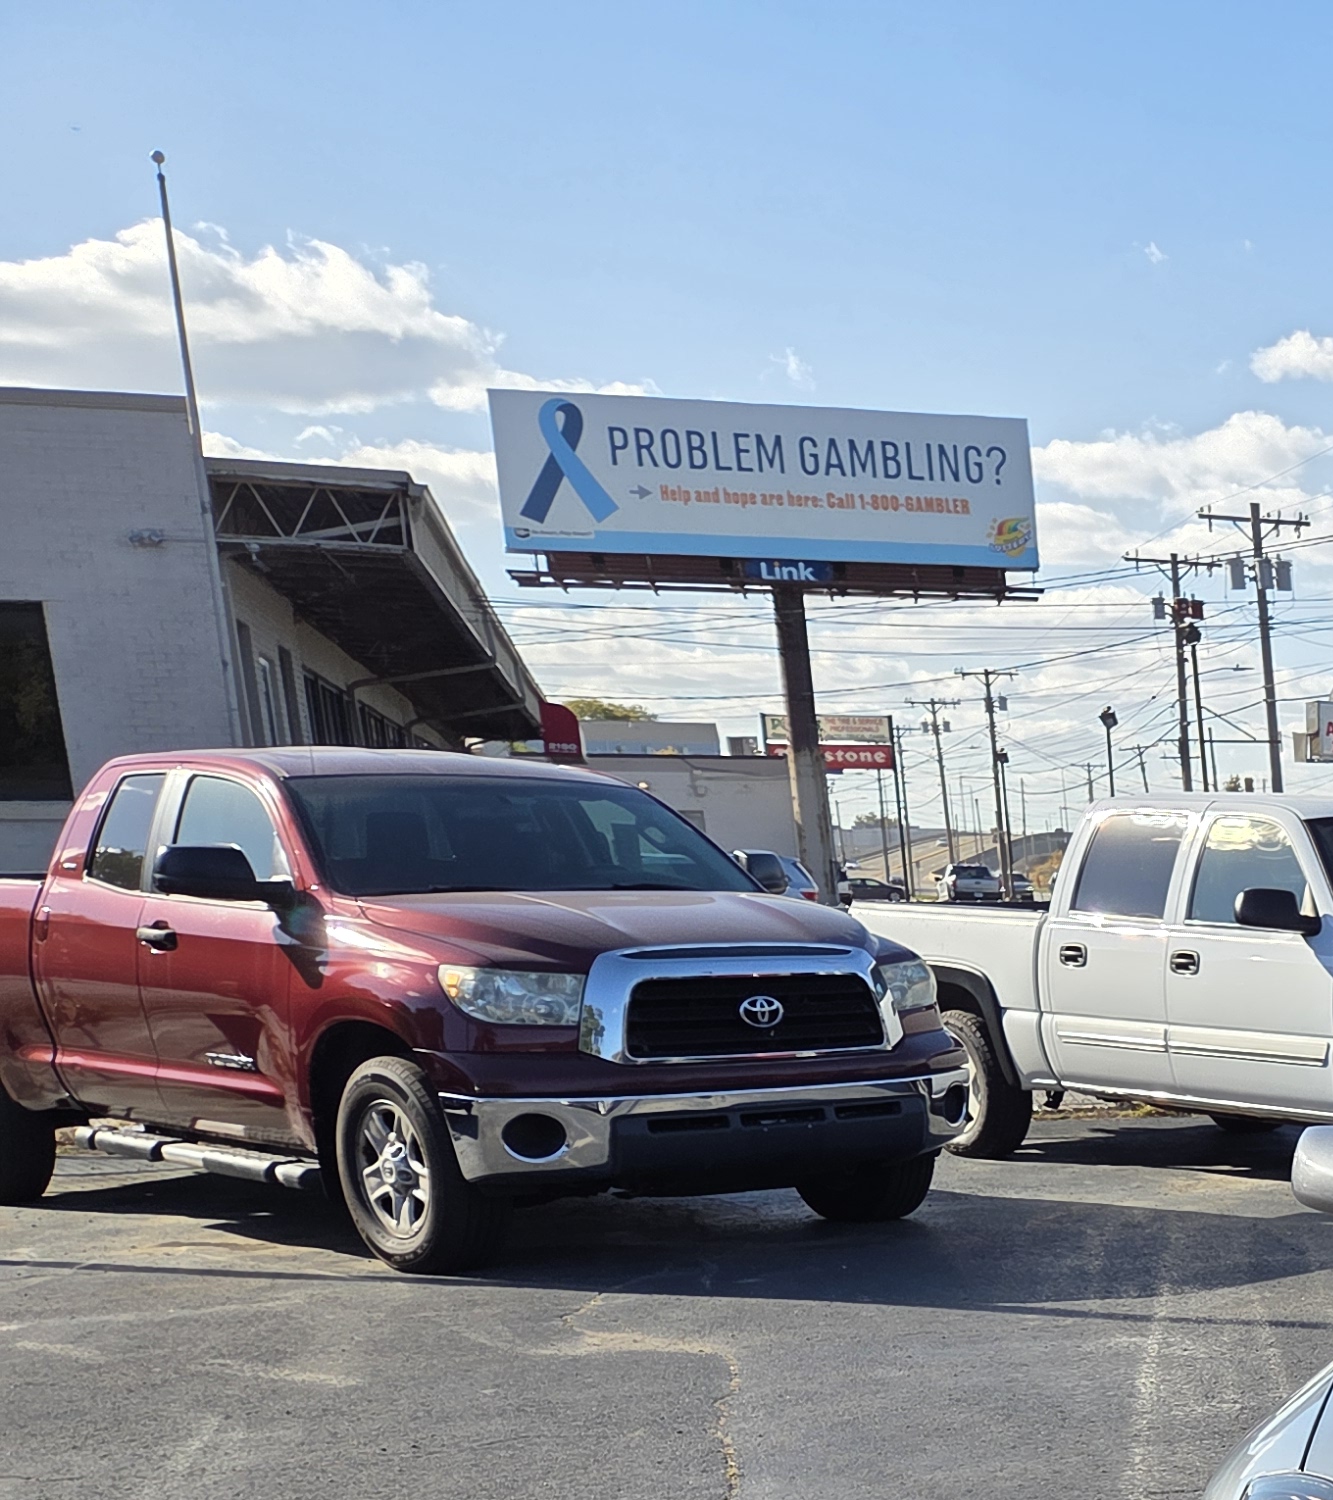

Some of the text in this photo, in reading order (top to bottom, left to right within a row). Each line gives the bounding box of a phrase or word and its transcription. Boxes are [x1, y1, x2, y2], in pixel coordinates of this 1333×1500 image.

[607, 426, 1007, 485] PROBLEM GAMBLING?
[660, 484, 972, 516] Help and hope are here: Call 1-800-GAMBLER
[760, 561, 818, 582] Link
